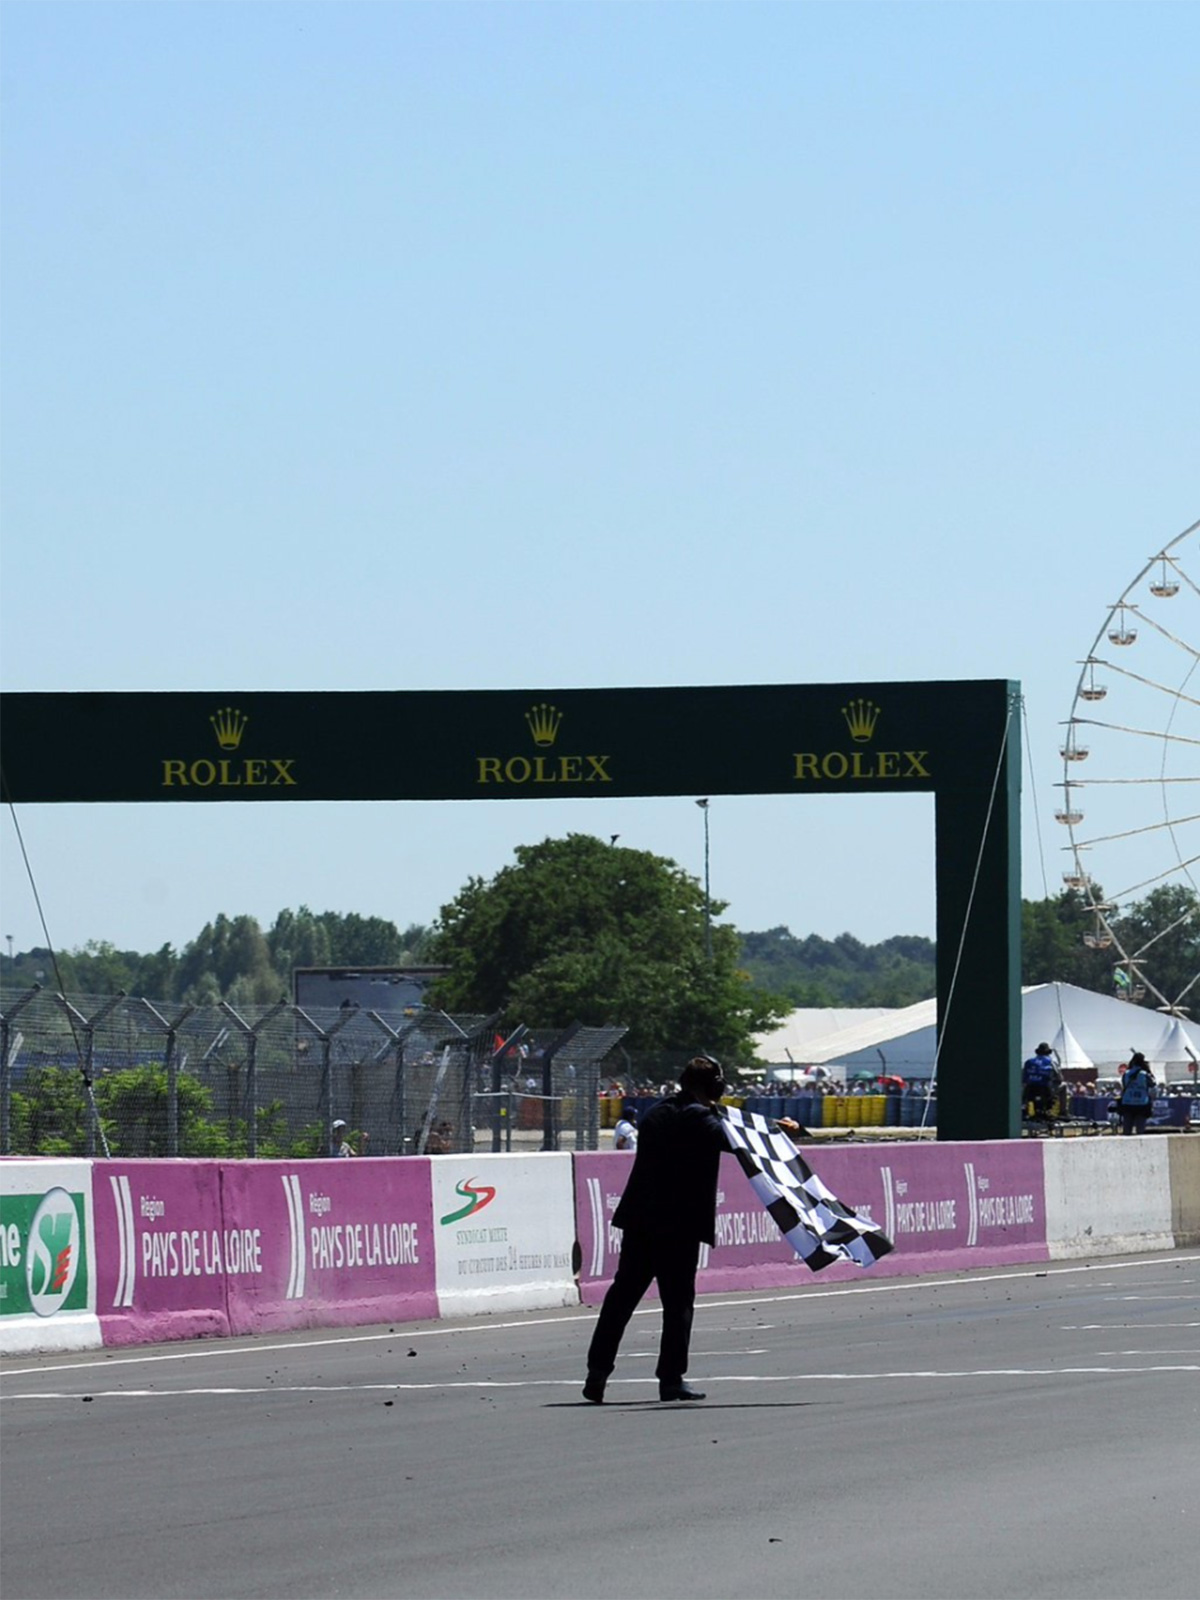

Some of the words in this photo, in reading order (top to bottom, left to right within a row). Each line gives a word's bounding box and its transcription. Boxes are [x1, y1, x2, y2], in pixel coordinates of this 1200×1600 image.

[162, 760, 297, 785] ROLEX
[476, 756, 613, 783] ROLEX
[793, 751, 931, 779] ROLEX
[140, 1196, 164, 1221] Région
[309, 1193, 331, 1217] Région
[896, 1203, 915, 1233] PAYS
[915, 1202, 926, 1232] DE
[926, 1202, 936, 1231] LA
[937, 1200, 957, 1230] LOIRE
[979, 1198, 997, 1227] PAYS
[997, 1197, 1007, 1225] DE
[1006, 1196, 1016, 1225] LA
[1016, 1195, 1034, 1223] LOIRE
[734, 1212, 746, 1245] DE
[747, 1212, 759, 1244] LA
[142, 1231, 179, 1277] PAYS
[181, 1230, 201, 1276] DE
[203, 1230, 223, 1274] LA
[224, 1228, 262, 1274] LOIRE
[311, 1225, 343, 1270] PAYS
[346, 1224, 362, 1267] DE
[364, 1224, 382, 1267] LA
[383, 1222, 419, 1265] LOIRE
